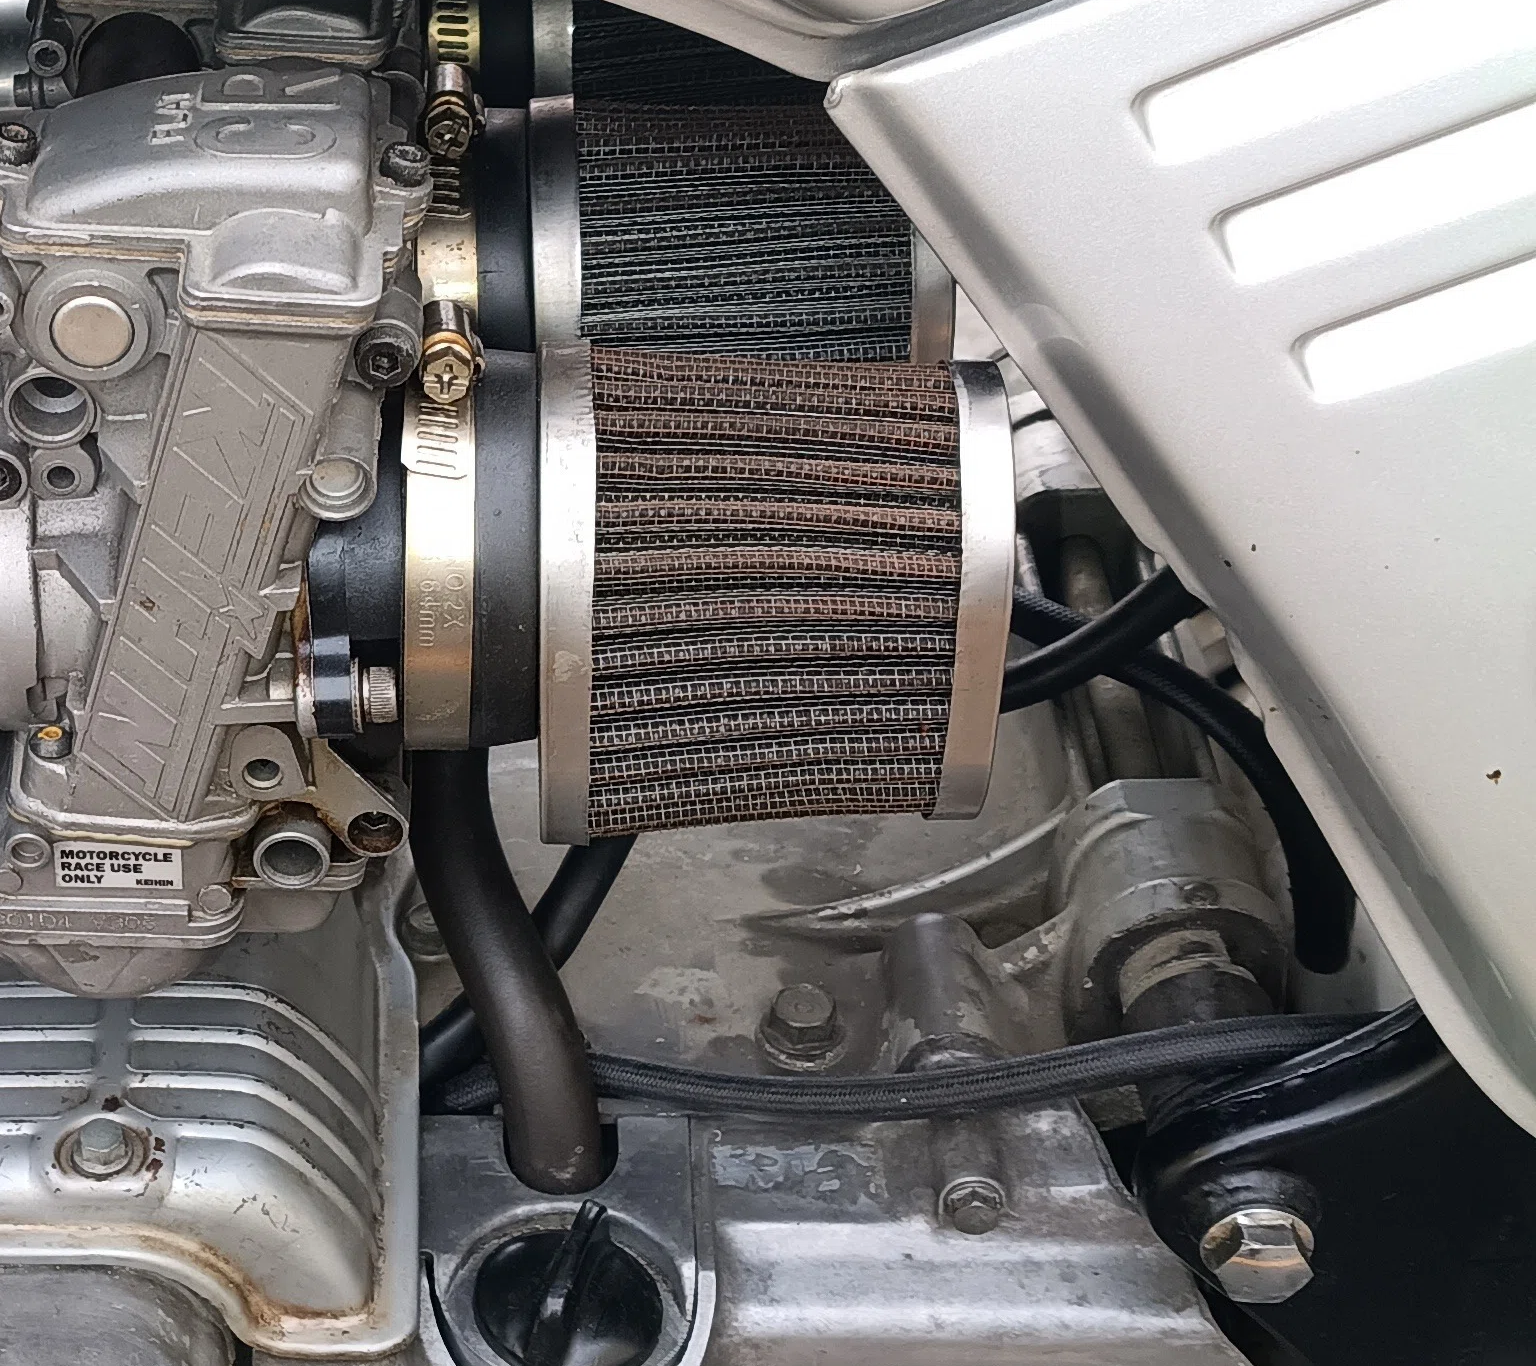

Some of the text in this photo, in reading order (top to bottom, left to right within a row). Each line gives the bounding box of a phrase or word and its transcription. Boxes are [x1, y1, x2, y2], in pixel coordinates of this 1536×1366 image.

[59, 849, 173, 863] MOTORCYCLE
[60, 861, 144, 874] RACE USE
[61, 873, 174, 887] ONLY KEIHIN
